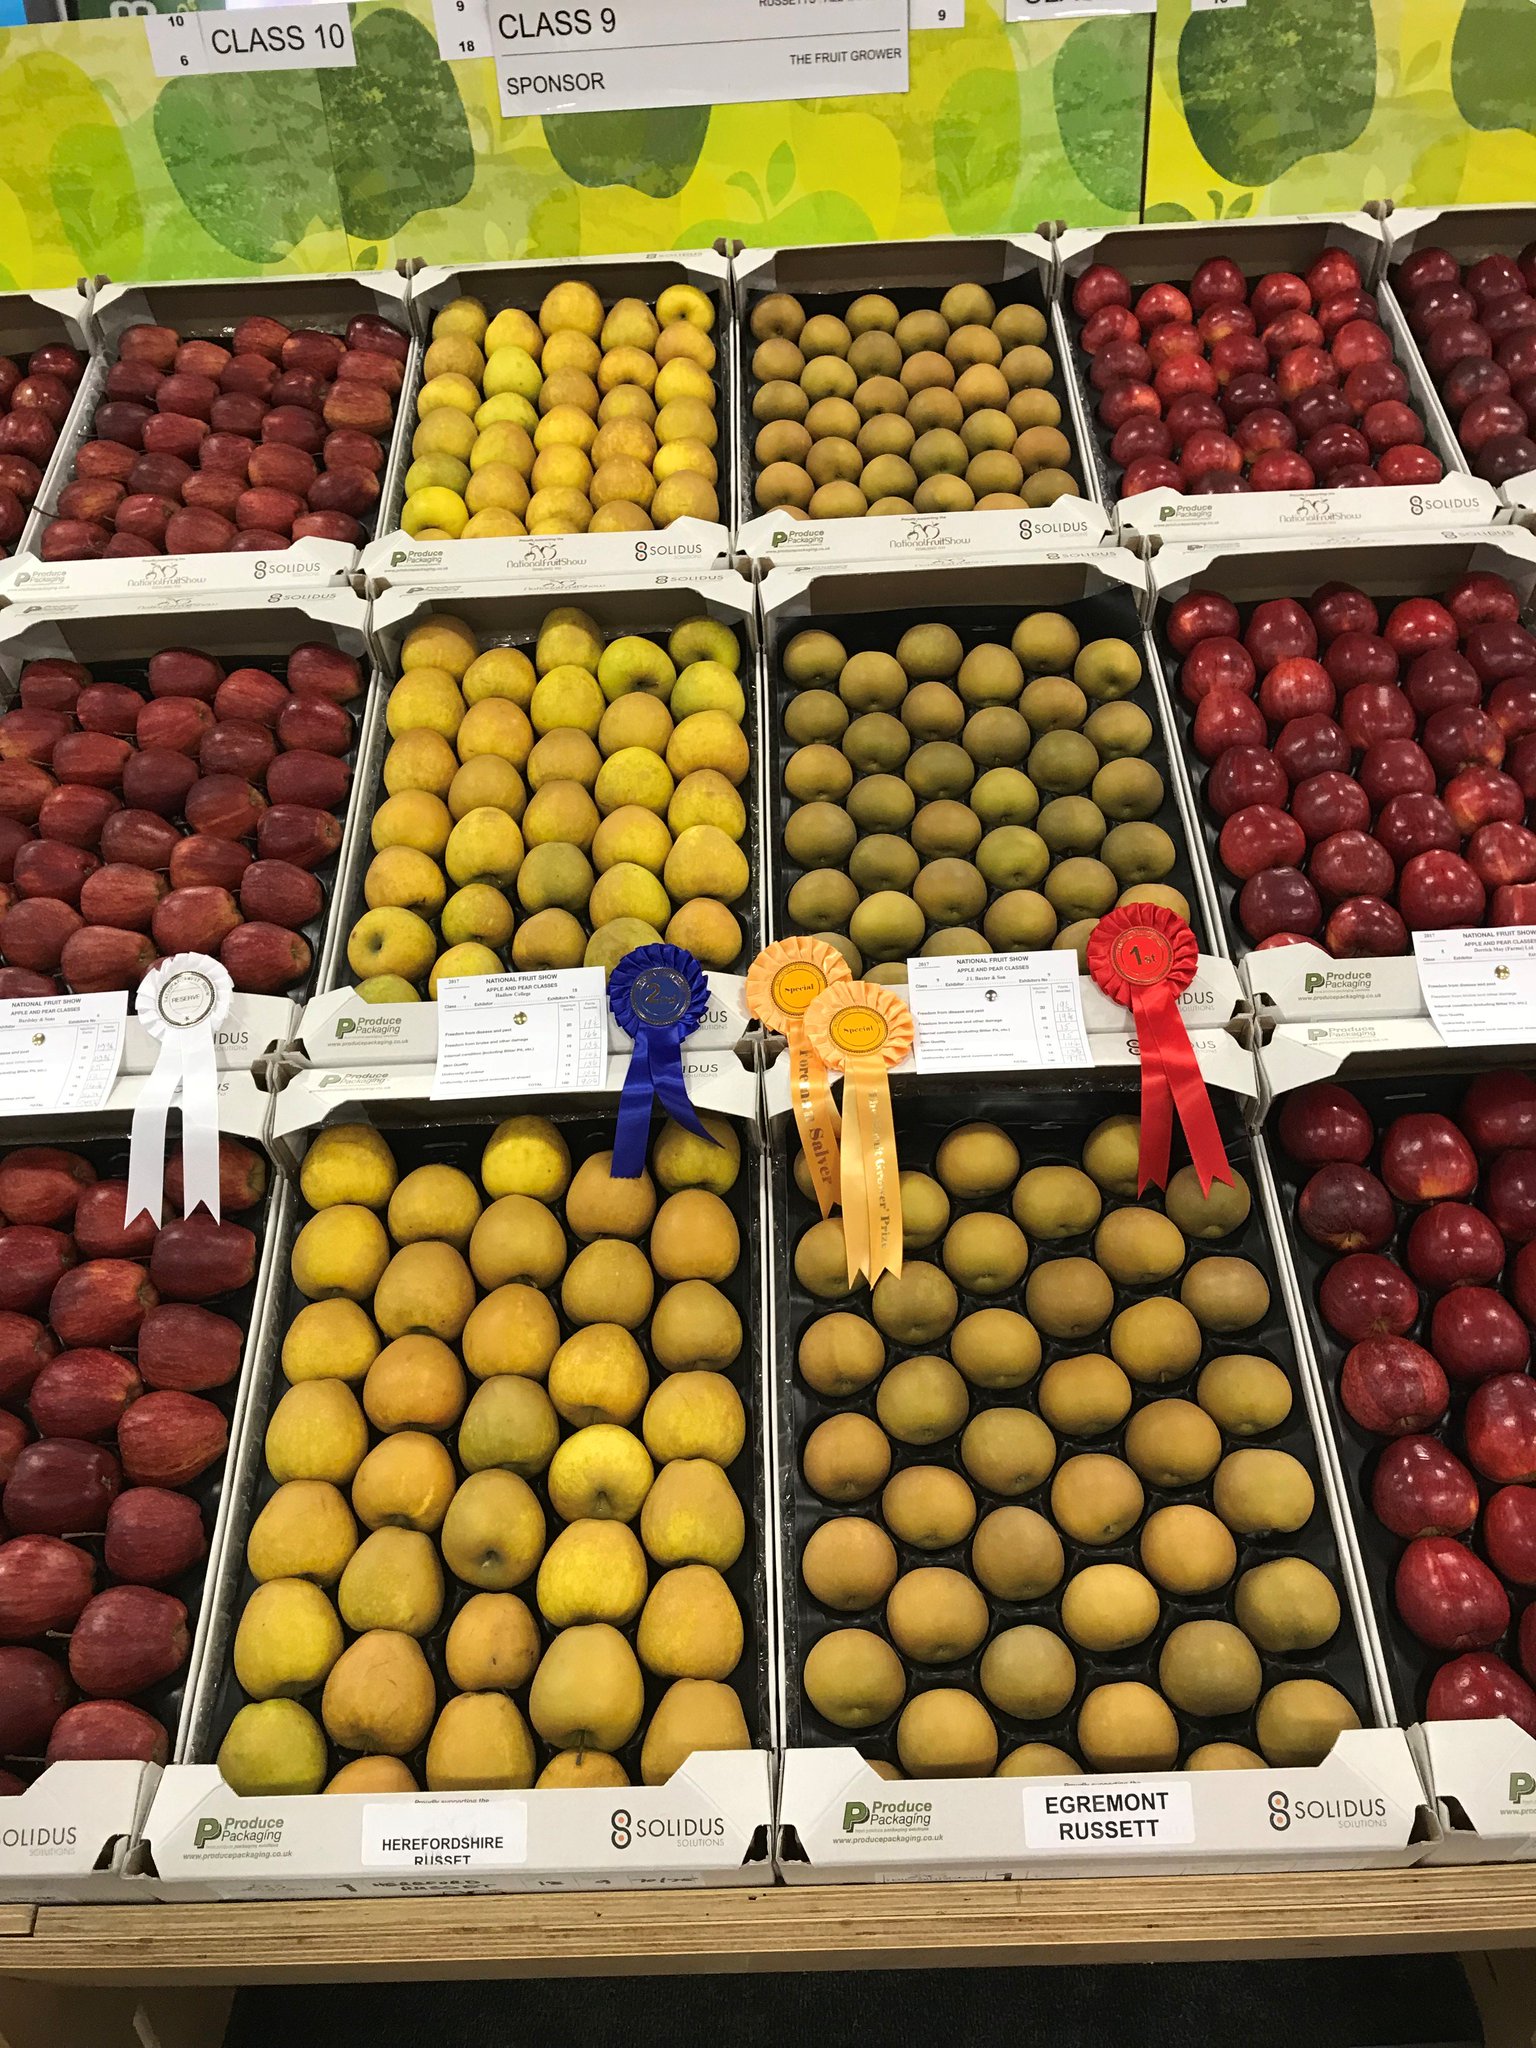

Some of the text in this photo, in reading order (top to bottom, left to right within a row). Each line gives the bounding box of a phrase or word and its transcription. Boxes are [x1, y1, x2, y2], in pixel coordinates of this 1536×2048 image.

[455, 0, 464, 12] 9
[167, 15, 185, 27] 10
[938, 9, 946, 21] 9
[498, 7, 616, 39] CLASS 9
[211, 23, 345, 55] CLASS 10
[458, 40, 475, 53] 18
[180, 55, 189, 66] 6
[790, 48, 902, 66] THE FRUIT GROWER
[506, 72, 606, 95] SPONSOR
[1425, 497, 1480, 510] SOLIDUS
[1034, 520, 1088, 533] SOLIDUS
[788, 529, 825, 539] Produce
[408, 550, 443, 560] Produce
[649, 543, 702, 555] SOLIDUS
[268, 562, 321, 575] SOLIDUS
[283, 592, 338, 601] SOLIDUS
[956, 958, 988, 966] NATIONAL
[989, 956, 1008, 964] FRUIT
[1004, 964, 1030, 972] CLASSES
[486, 976, 517, 984] NATIONAL
[538, 973, 558, 981] SHOW
[1326, 971, 1372, 981] Produce
[1325, 979, 1372, 989] Packaging
[11, 997, 82, 1009] NATIONAL FRUIT SHOW
[171, 993, 200, 1004] RESERVE
[1177, 990, 1215, 1006] IDUS
[10, 1009, 29, 1017] APPLE
[57, 1006, 81, 1014] CLASSES
[357, 1016, 402, 1027] Produce
[356, 1024, 401, 1036] Packaging
[213, 1031, 249, 1046] IDUS
[682, 1063, 719, 1074] IDUS
[346, 1071, 389, 1080] Produce
[808, 1126, 833, 1186] Salver
[880, 1214, 891, 1251] Prize
[872, 1800, 933, 1814] Produce
[1045, 1791, 1169, 1815] EGREMONT
[1294, 1798, 1386, 1820] SOLIDUS
[224, 1816, 285, 1831] Produce
[870, 1812, 932, 1828] Packaging
[1338, 1818, 1388, 1829] SOLUTIONS
[636, 1817, 725, 1838] SOLIDUS
[1059, 1819, 1160, 1841] RUSSETT
[2, 1826, 77, 1847] OLIDUS
[221, 1829, 283, 1844] Packaging
[832, 1833, 944, 1845] www.producepackaging.co.uk
[382, 1836, 504, 1852] HEREFORDSHIRE
[677, 1838, 725, 1848] SOLUTIONS
[182, 1850, 294, 1861] www.producepackaging.co.uk
[414, 1854, 472, 1866] RUSSET
